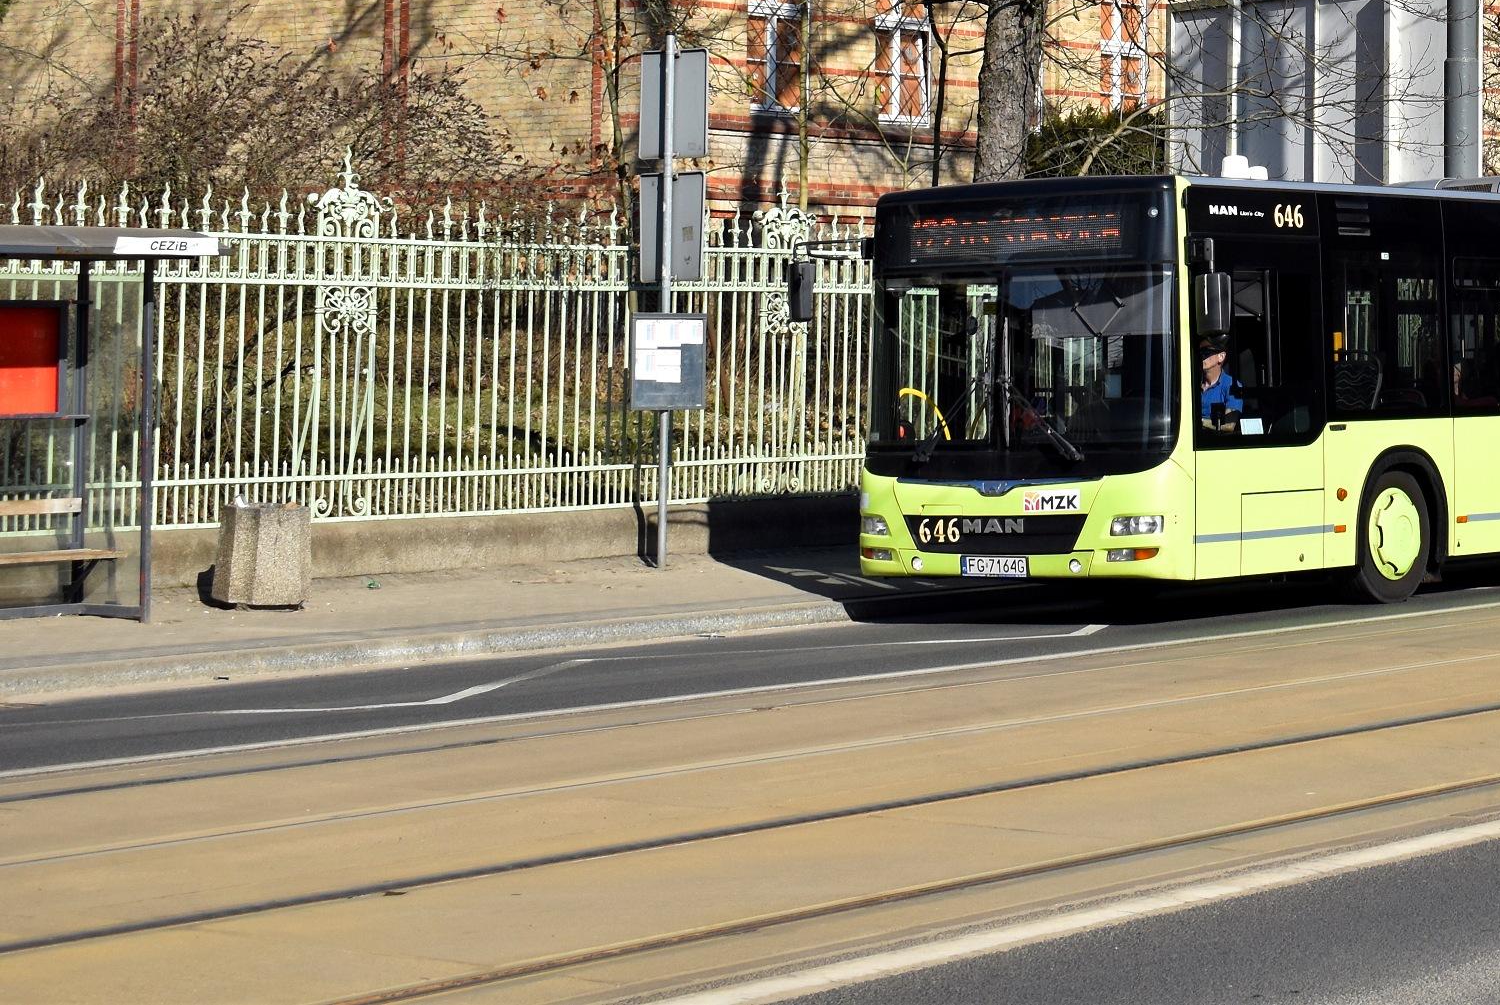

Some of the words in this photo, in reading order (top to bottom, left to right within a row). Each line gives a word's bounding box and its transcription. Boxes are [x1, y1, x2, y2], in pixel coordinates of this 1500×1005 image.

[1208, 204, 1238, 216] MAN
[1254, 210, 1265, 218] City
[1273, 203, 1304, 229] 646
[150, 240, 188, 251] CEZiB
[1040, 494, 1078, 511] MZK
[918, 517, 961, 544] 646
[962, 518, 1025, 534] MAN
[968, 558, 986, 573] FG
[988, 558, 1025, 574] 7164G
